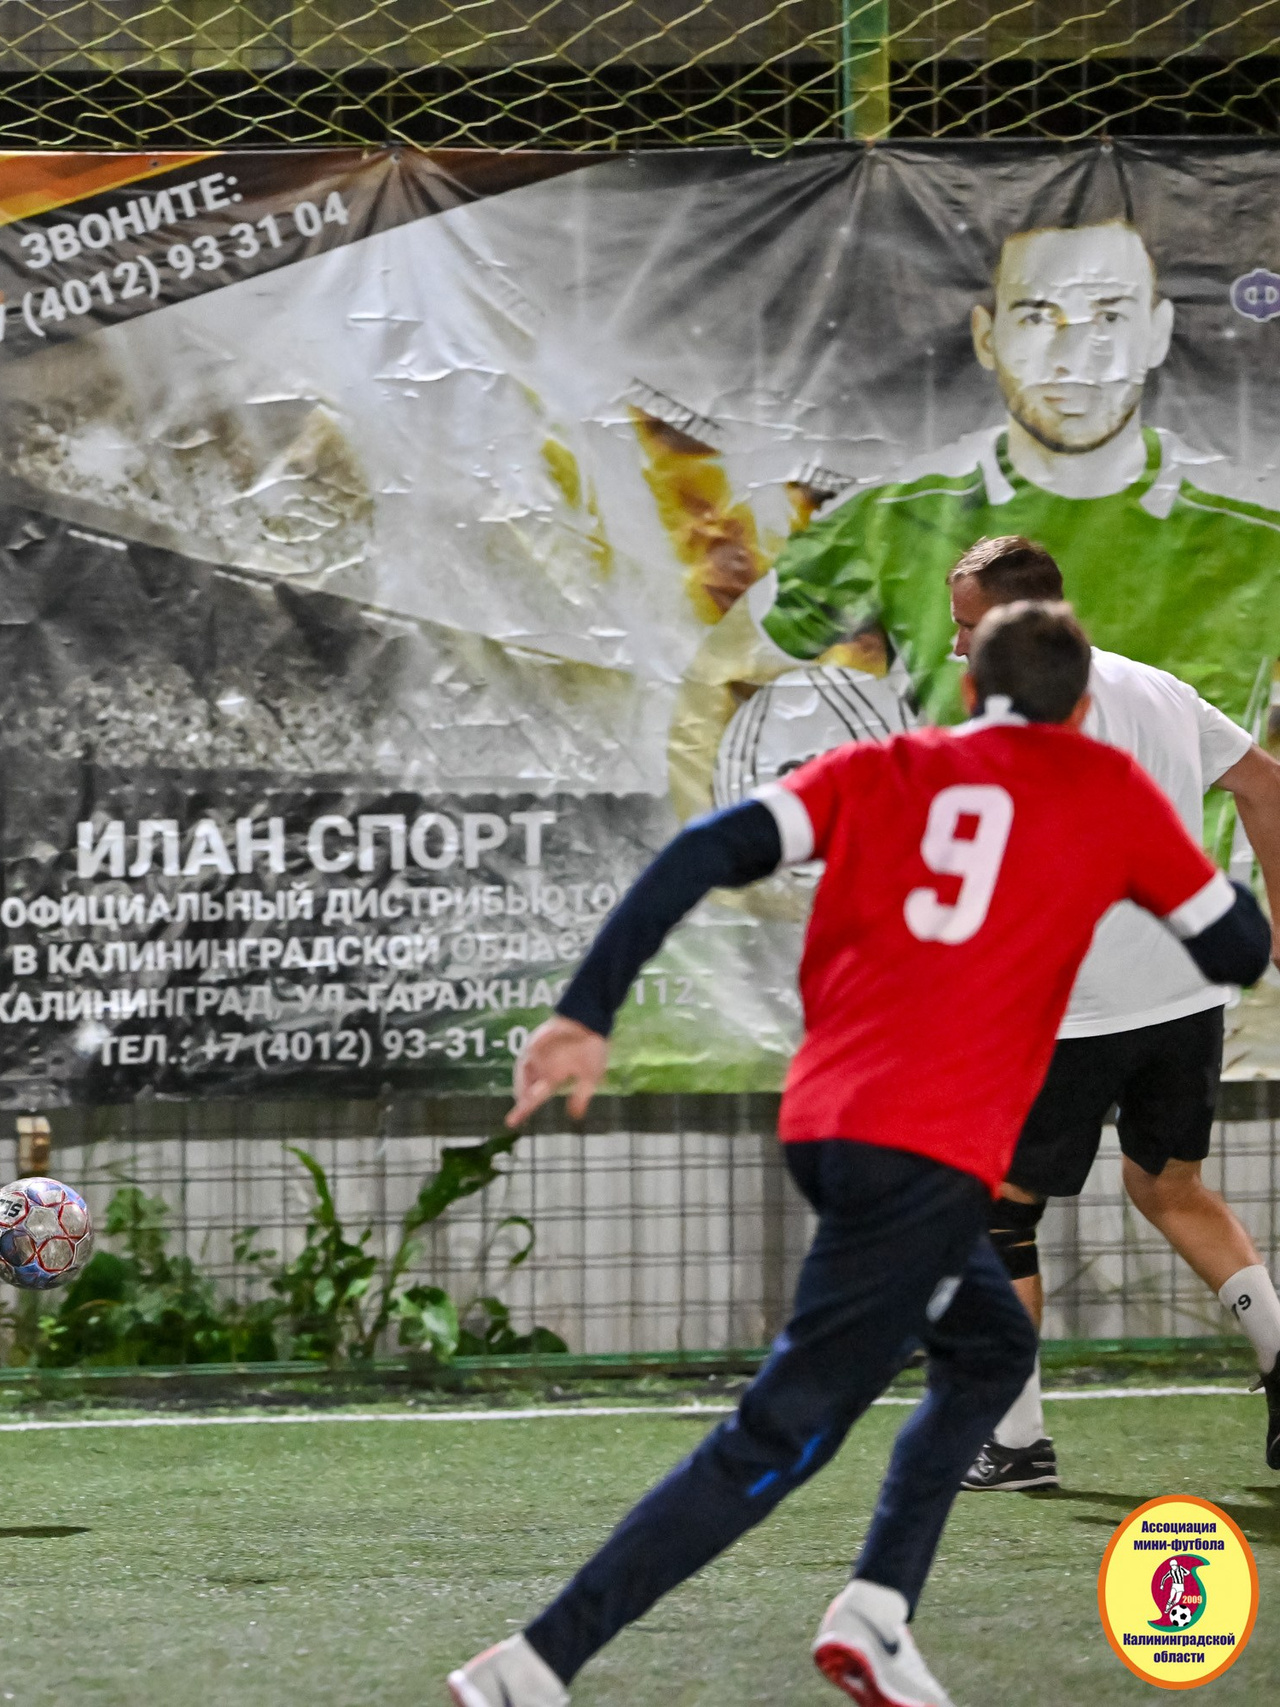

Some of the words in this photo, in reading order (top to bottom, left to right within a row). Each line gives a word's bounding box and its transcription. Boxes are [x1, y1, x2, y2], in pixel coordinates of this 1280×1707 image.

[21, 172, 243, 268] ЗВОНИТЕ:
[22, 256, 159, 337] (4012)
[168, 236, 224, 280] 93
[229, 215, 282, 260] 31
[294, 191, 349, 238] 04
[76, 817, 286, 879] ИЛАН
[307, 810, 558, 874] СПОРТ
[904, 784, 1014, 945] 9
[0, 882, 314, 931] ОФИЦИАЛЬНЫЙ
[322, 883, 617, 926] ДИСТРИБЬЮТО
[13, 945, 38, 975] В
[47, 933, 440, 974] КАЛИНИНГРАДСКОЙ
[201, 1031, 242, 1063] +7
[254, 1028, 372, 1070] (4012)
[382, 1025, 528, 1061] 93-31-0
